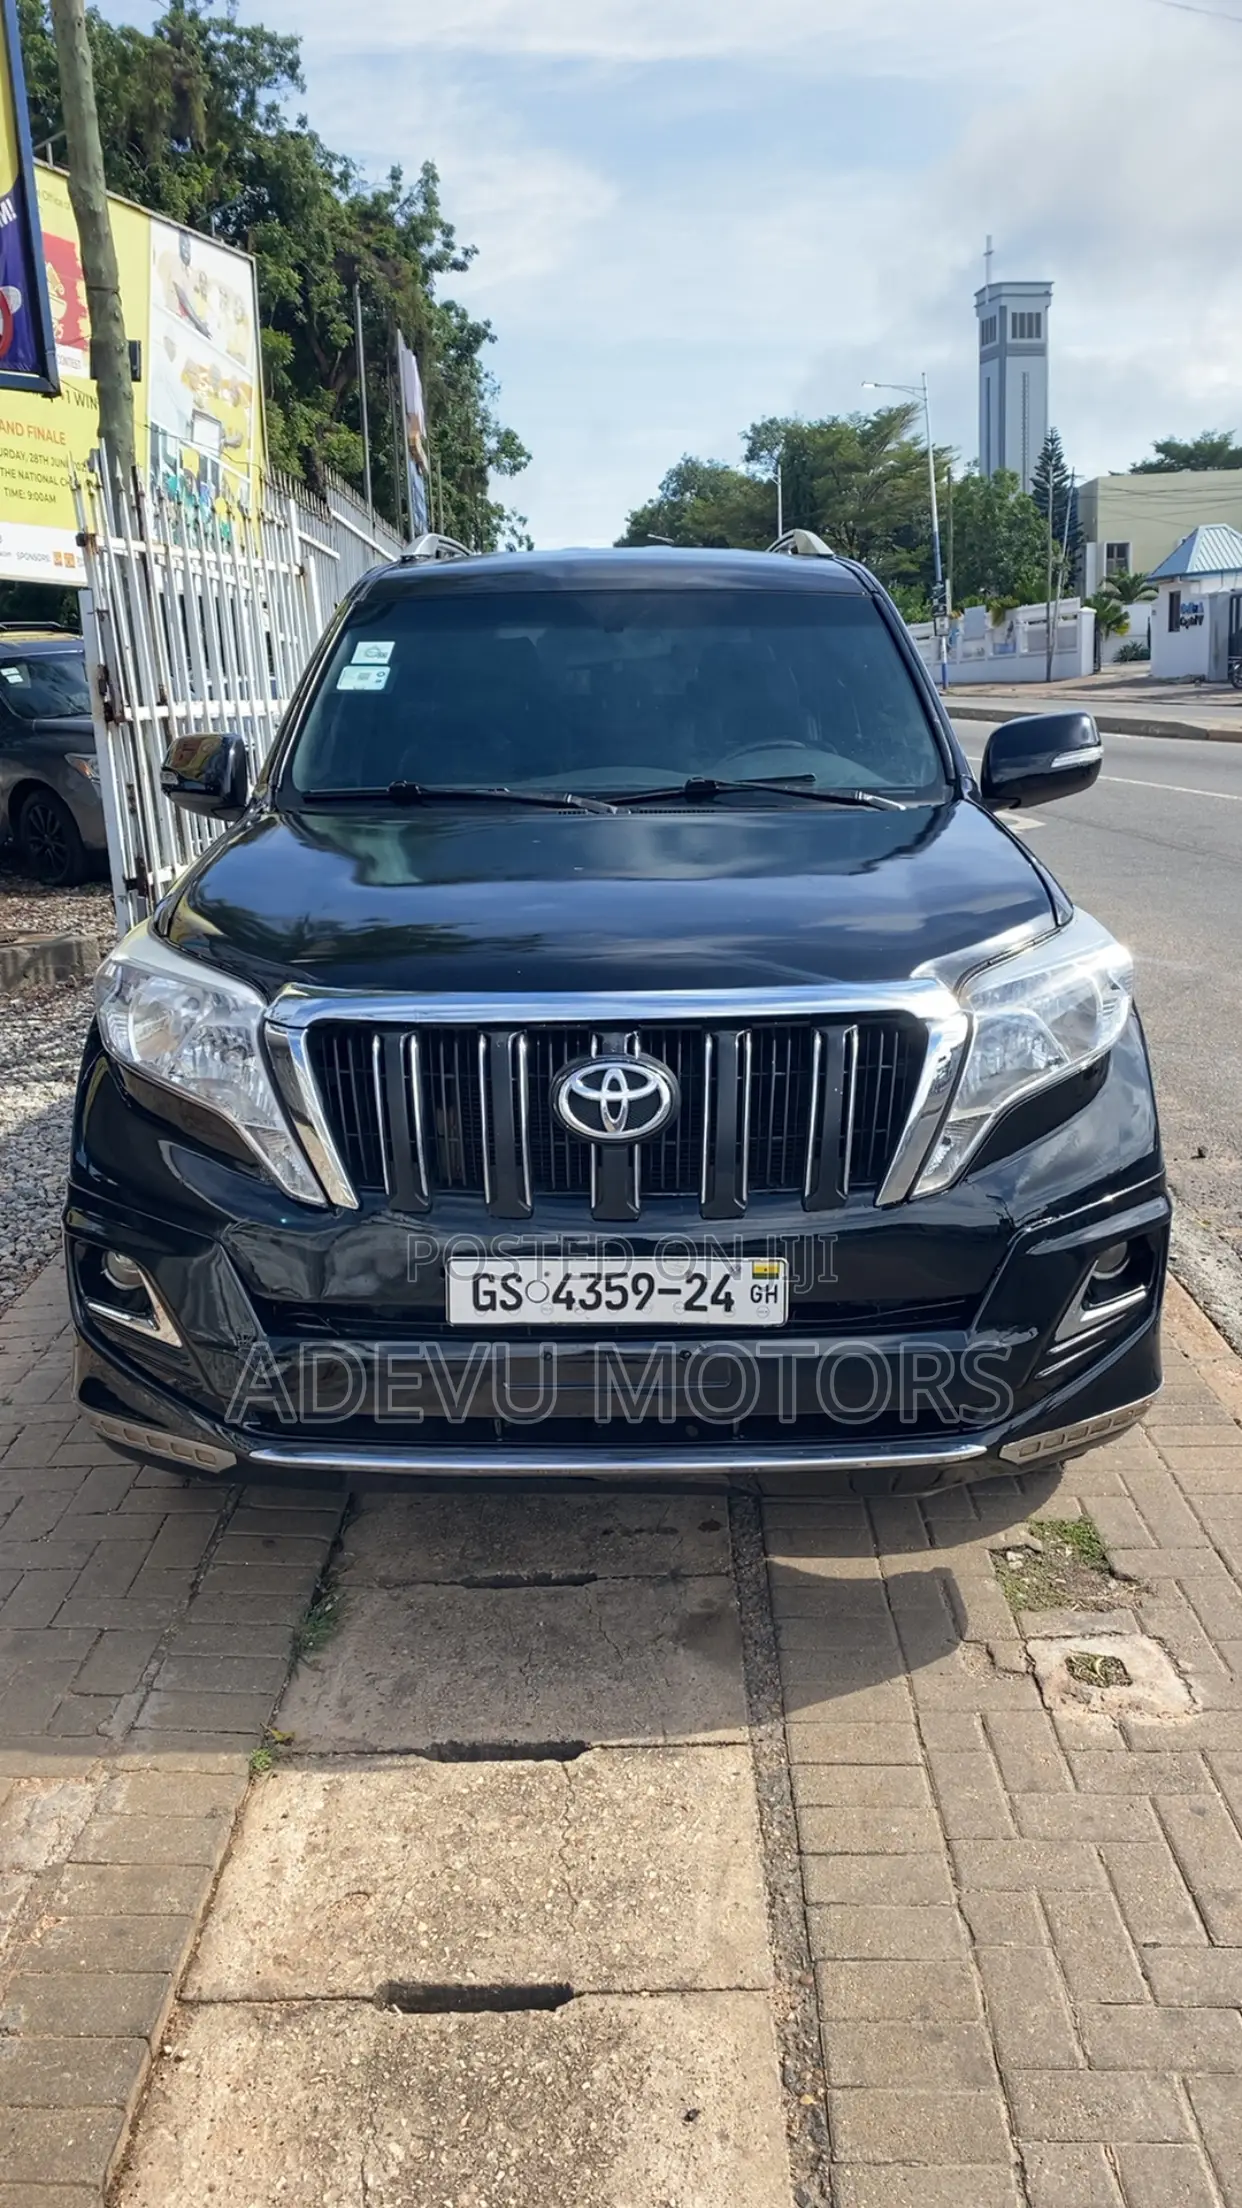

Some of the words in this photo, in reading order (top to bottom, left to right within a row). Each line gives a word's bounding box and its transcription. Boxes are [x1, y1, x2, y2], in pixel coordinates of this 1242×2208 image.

[27, 425, 66, 445] FINALE
[0, 467, 16, 478] THE
[18, 471, 59, 487] NATIONAL
[472, 1273, 523, 1312] GS
[552, 1273, 735, 1312] 4359-24
[750, 1284, 778, 1304] GH
